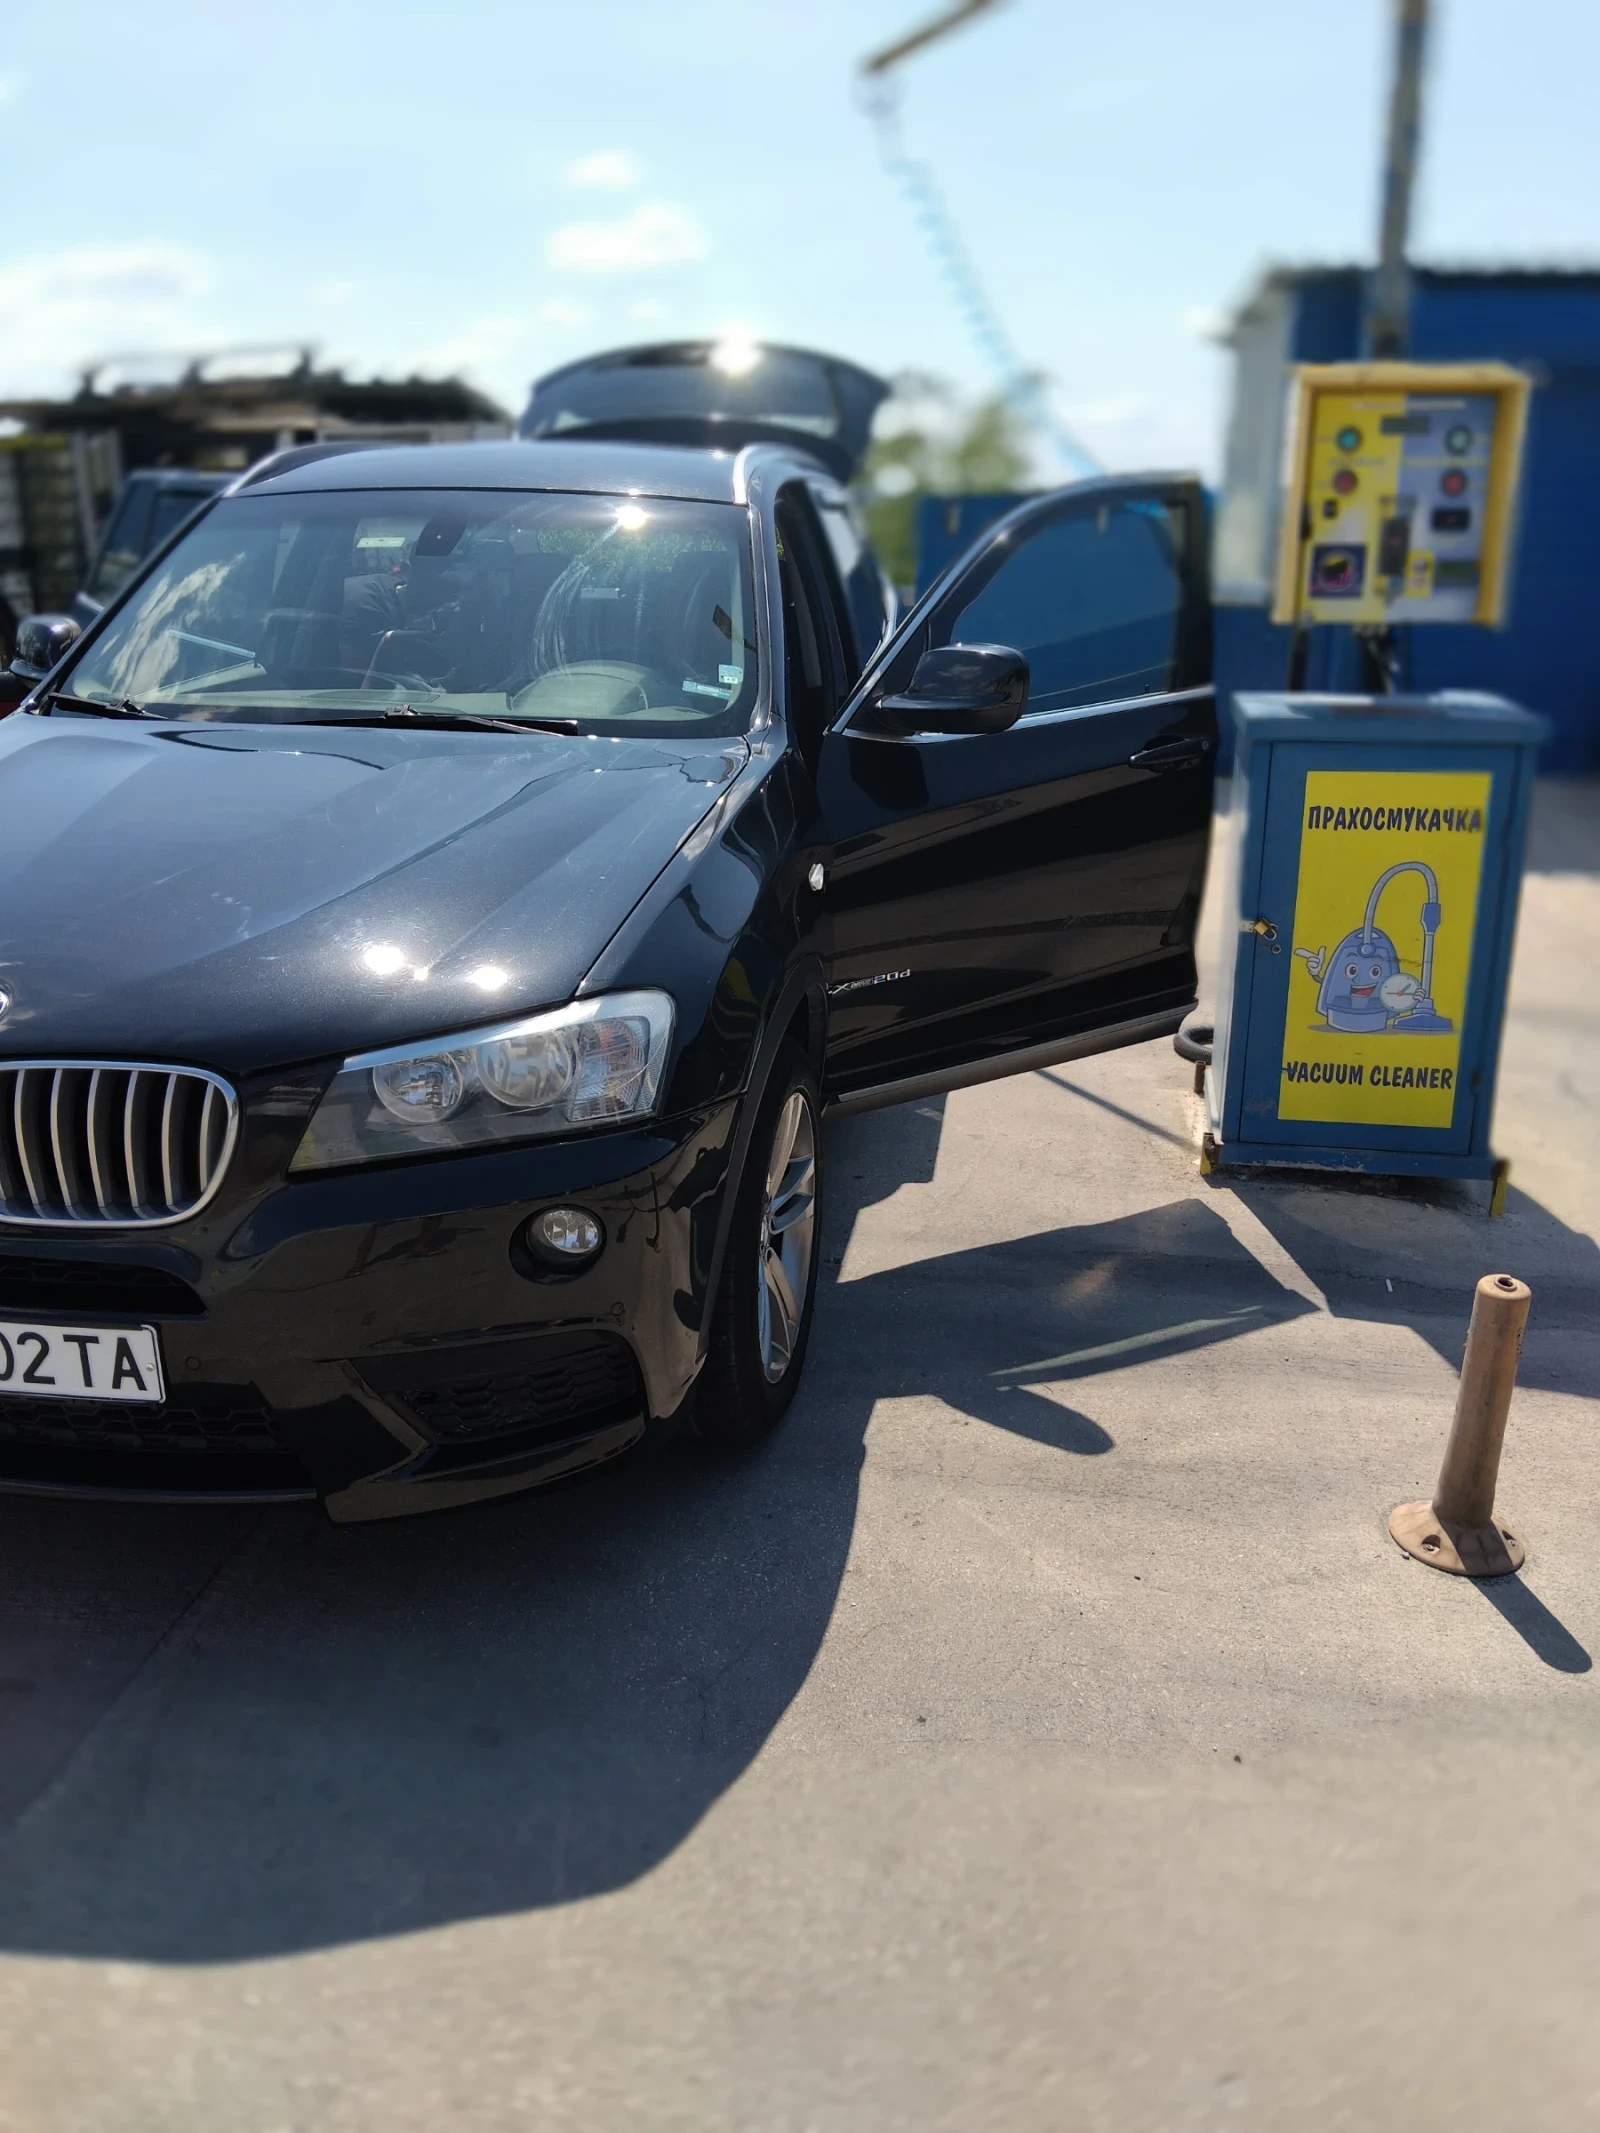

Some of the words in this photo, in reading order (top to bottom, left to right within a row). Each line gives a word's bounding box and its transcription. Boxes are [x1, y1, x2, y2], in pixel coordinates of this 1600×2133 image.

[1307, 805, 1482, 833] ПРАХОСМУКАЧКА
[1286, 1060, 1364, 1086] VACUUM
[1369, 1065, 1454, 1090] CLEANER
